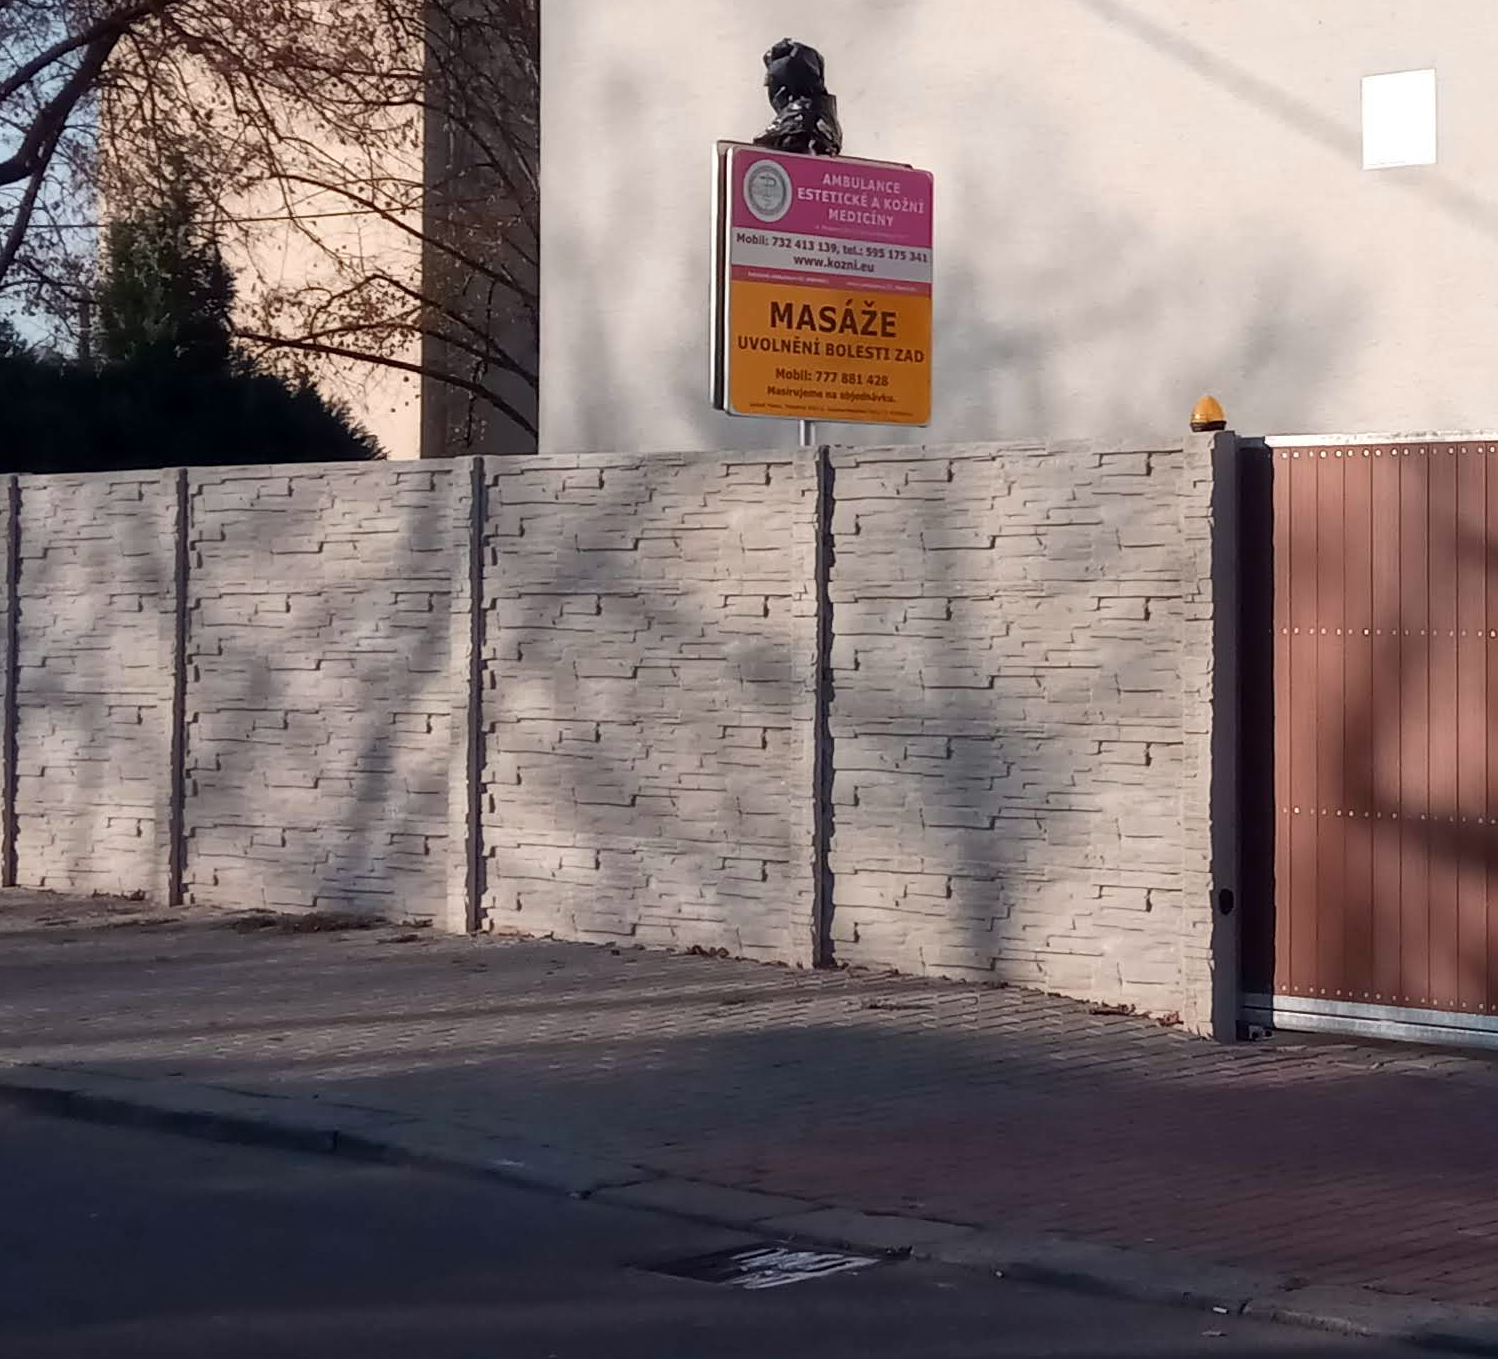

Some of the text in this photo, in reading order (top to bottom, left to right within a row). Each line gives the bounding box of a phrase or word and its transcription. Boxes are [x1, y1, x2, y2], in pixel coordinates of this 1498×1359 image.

[822, 173, 901, 194] AMBULANCE
[797, 187, 925, 214] ESTETICKÉ A KOŽNÍ
[828, 207, 894, 227] MEDICÍNY
[736, 233, 927, 263] Mobil: 732 413 139, tel.: 595 175 341
[793, 253, 875, 273] www.kozni.eu
[770, 298, 897, 338] MASÁŽE
[738, 335, 925, 363] UVOLNĚNÍ BOLESTI ZAD
[775, 367, 889, 387] Mobil: 777 881 428
[825, 390, 836, 400] na
